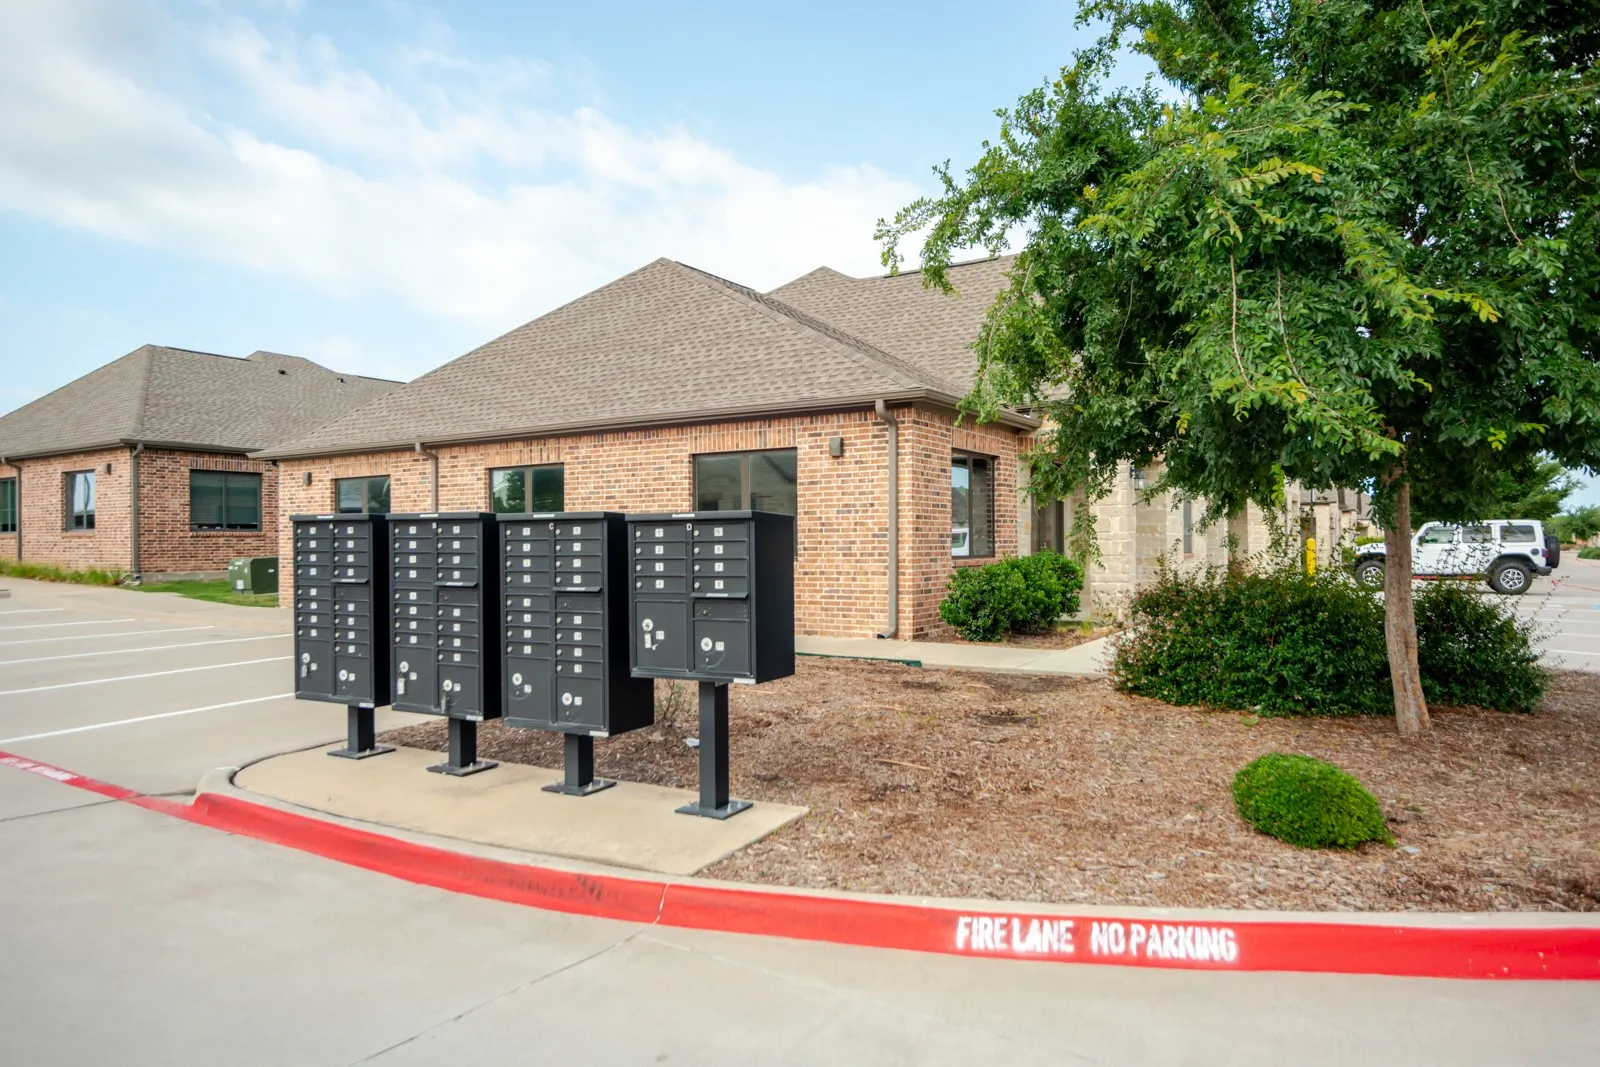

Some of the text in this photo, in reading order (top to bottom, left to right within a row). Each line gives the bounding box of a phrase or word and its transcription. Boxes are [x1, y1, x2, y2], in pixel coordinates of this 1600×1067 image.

[686, 523, 692, 531] D
[956, 916, 1238, 962] FIRE LANE NO PARKING
